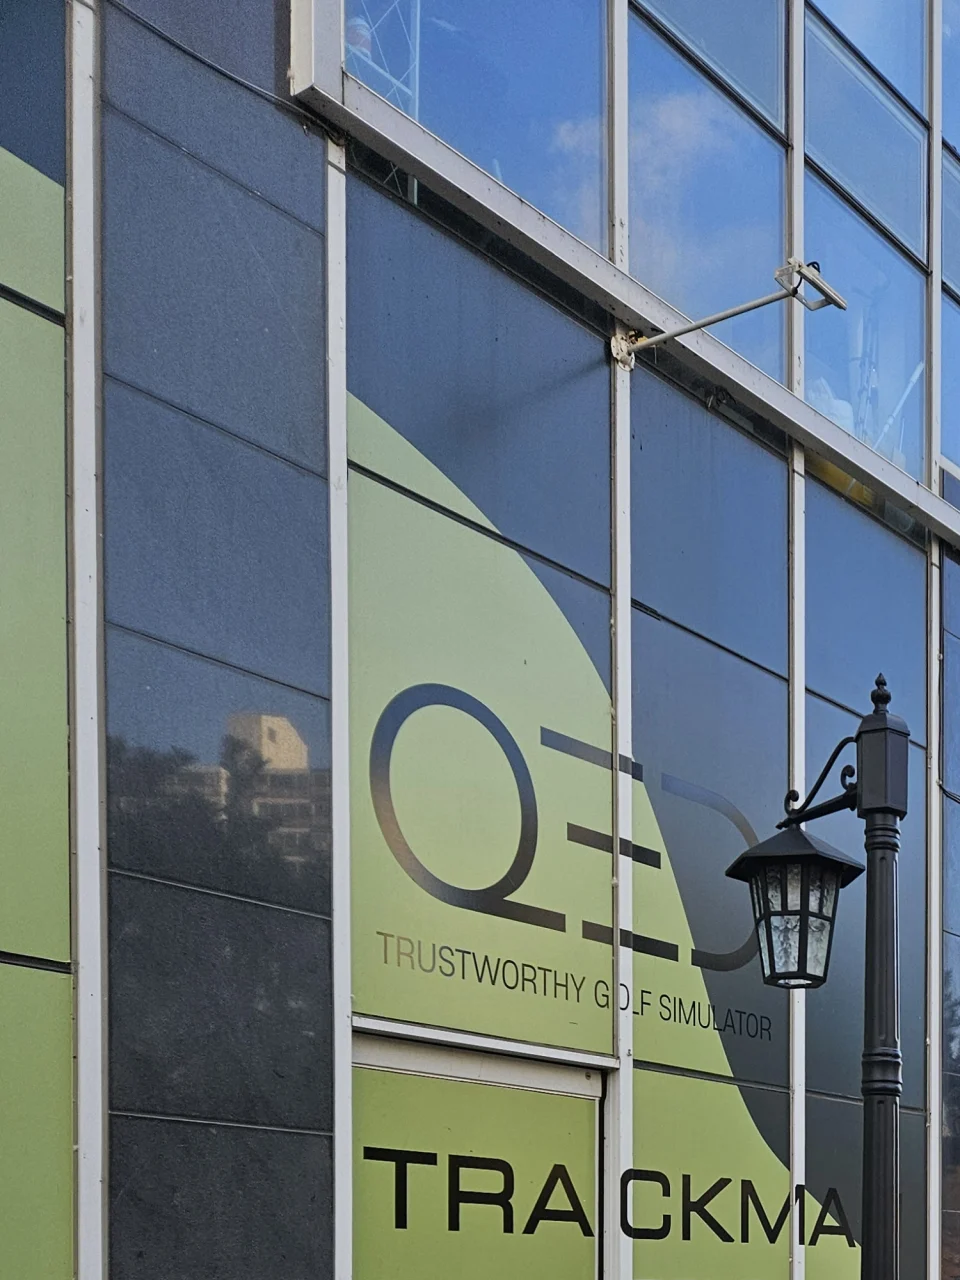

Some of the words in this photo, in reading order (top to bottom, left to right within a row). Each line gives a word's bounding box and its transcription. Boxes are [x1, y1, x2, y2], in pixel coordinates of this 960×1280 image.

[376, 931, 586, 1003] TRUSTWORTHY
[594, 980, 652, 1016] GOF
[659, 994, 773, 1041] SIMULATOR
[362, 1146, 857, 1247] TRACKMA
